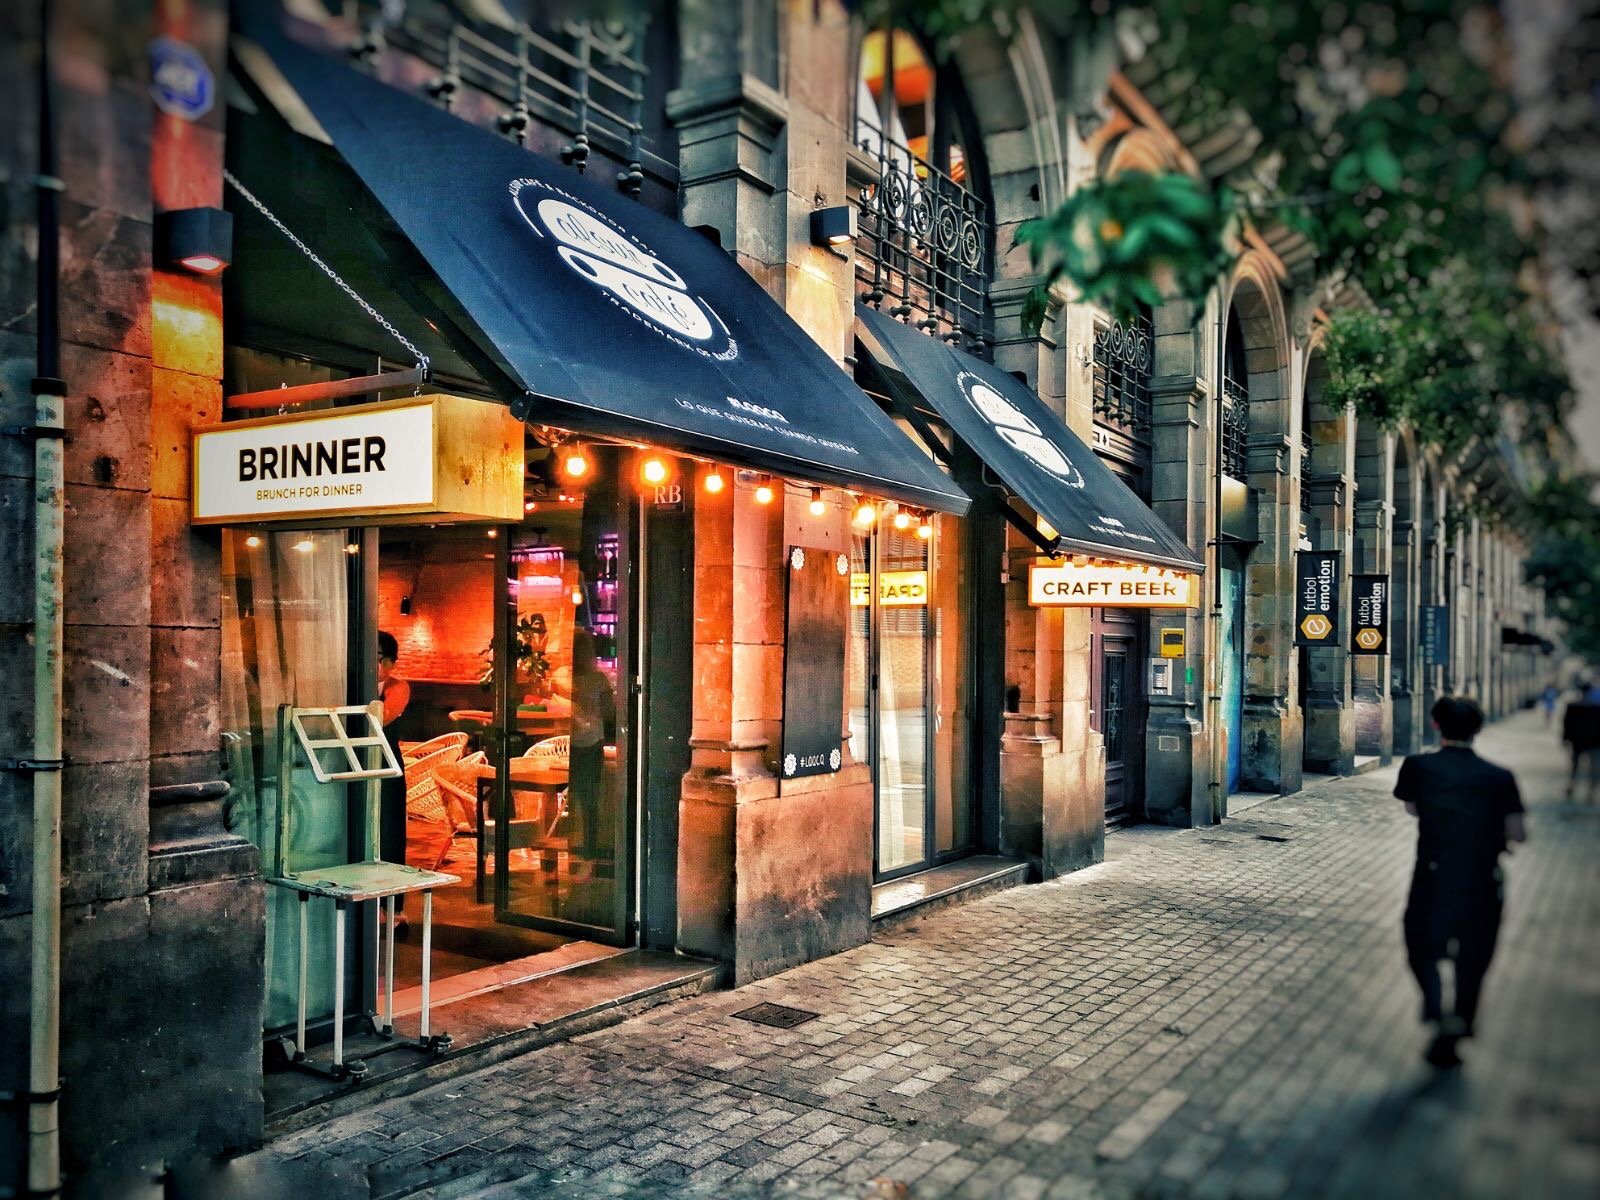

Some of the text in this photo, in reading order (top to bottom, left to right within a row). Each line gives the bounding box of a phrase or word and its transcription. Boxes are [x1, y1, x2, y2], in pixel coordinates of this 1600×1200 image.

[555, 187, 626, 233] BACKDOOR
[631, 235, 658, 257] BAR
[602, 290, 695, 352] TRADEMARK
[695, 347, 711, 358] OF
[674, 397, 860, 455] LO QUE QUIERAS CUANDO QUIERAS
[239, 436, 386, 482] BRINNER
[256, 483, 363, 501] BRUNCH FOR DINNER
[653, 484, 682, 505] RB
[1043, 582, 1177, 596] CRAFT BEER
[1303, 577, 1317, 611] futbol
[1317, 559, 1331, 612] emotion
[1369, 582, 1382, 627] emotion
[1357, 596, 1370, 626] futbol
